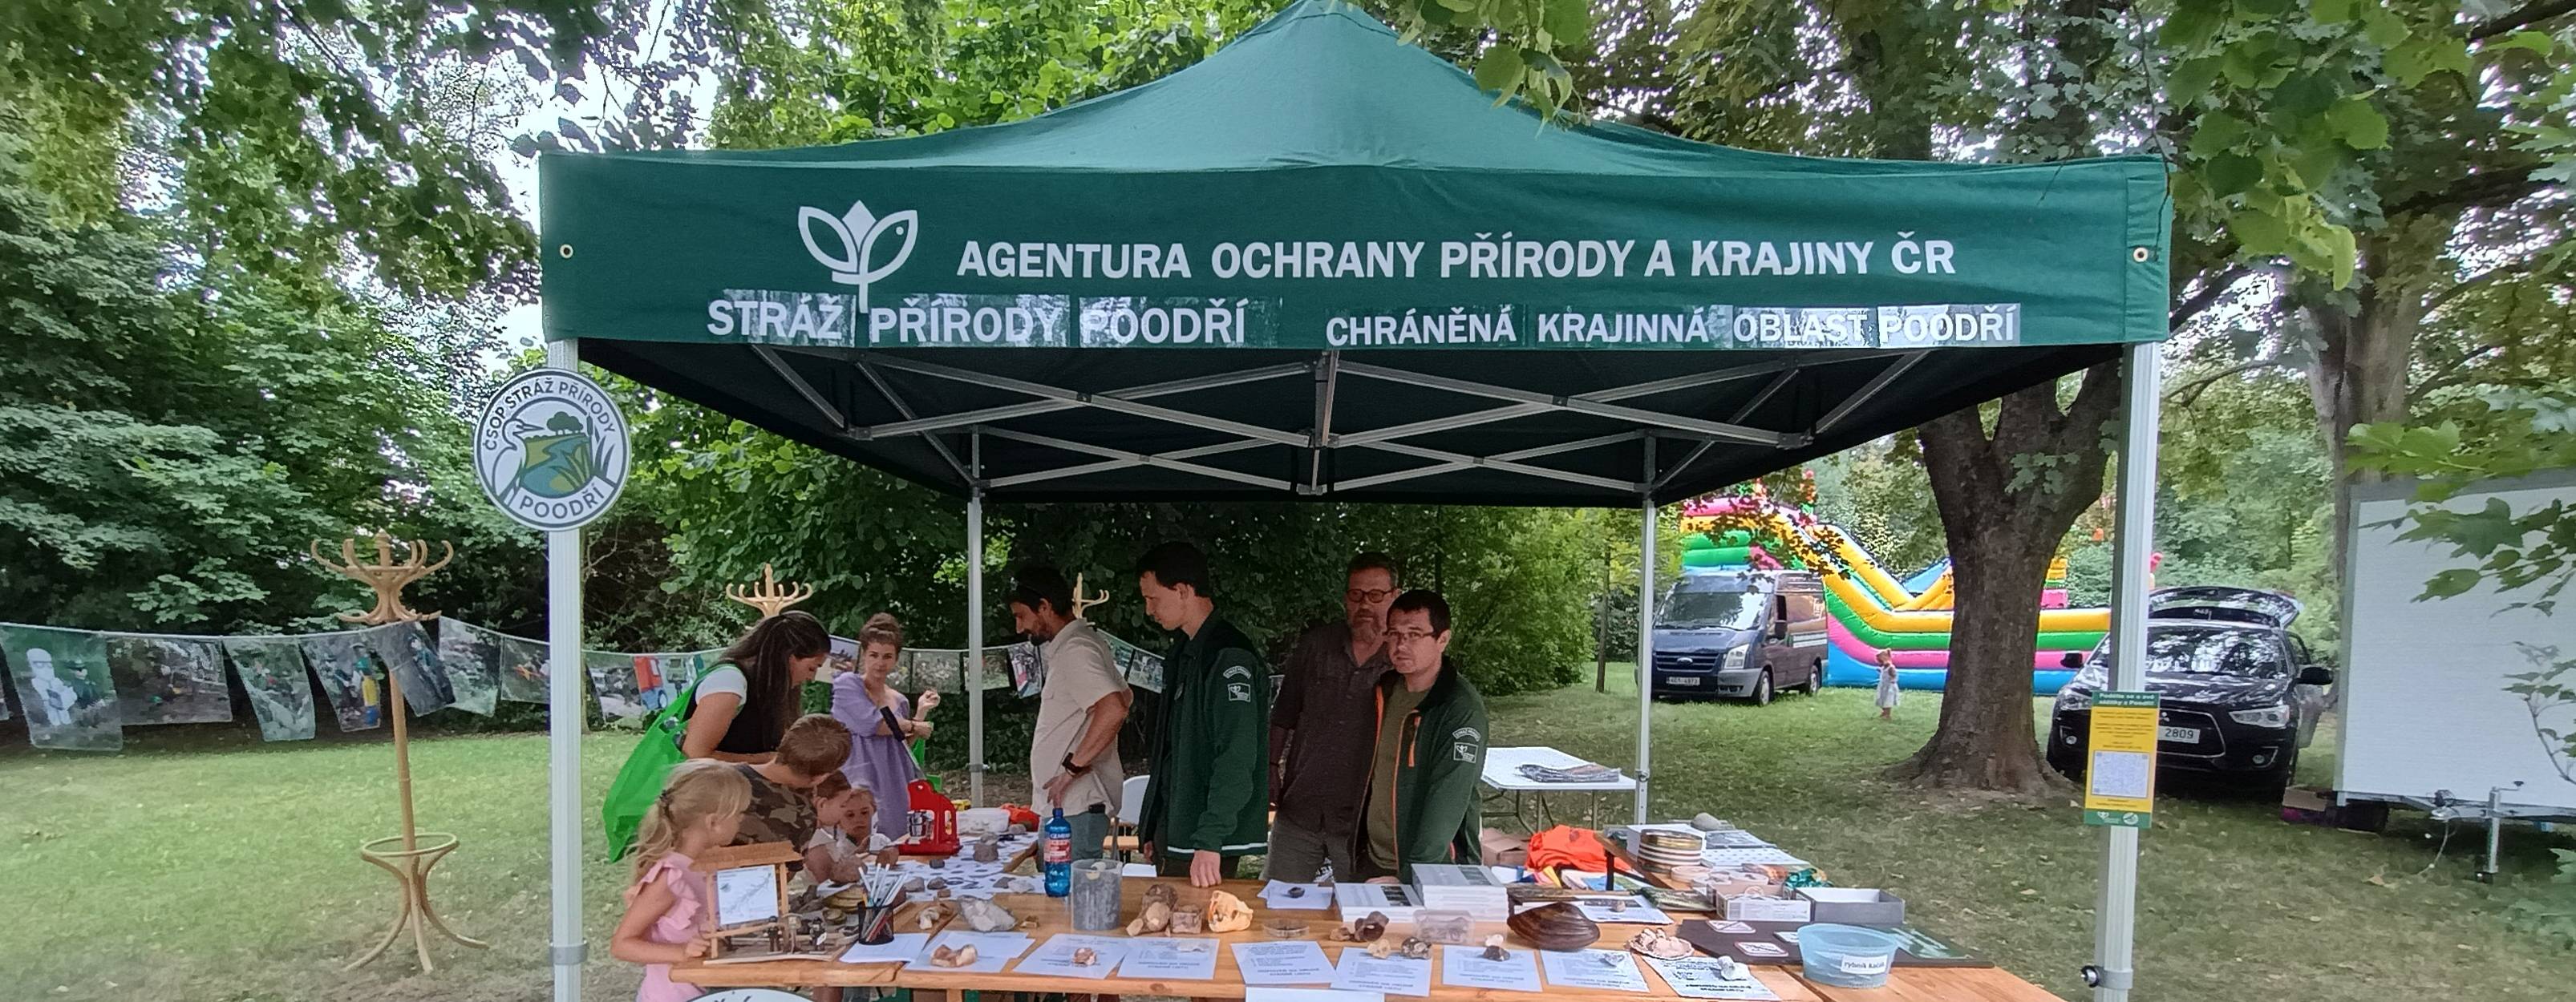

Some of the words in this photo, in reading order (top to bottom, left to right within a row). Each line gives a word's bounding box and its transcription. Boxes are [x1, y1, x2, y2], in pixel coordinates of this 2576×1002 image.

[958, 241, 1192, 279] AGENTURA
[1212, 240, 1425, 278] OCHRANY
[1440, 232, 1635, 278] PŘÍRODY
[1644, 241, 1675, 277] A
[1691, 240, 1874, 277] KRAJINY
[1891, 232, 1956, 275] ČR
[707, 294, 843, 339] STRÁŽ
[871, 297, 1064, 343] PŘÍRODY
[1081, 297, 1250, 344] POODŘÍ
[1326, 307, 1517, 346] CHRÁNĚNÁ
[1538, 308, 1709, 343] KRAJINNÁ
[1733, 313, 1868, 342] OBLAST
[1878, 304, 2018, 343] POODŘÍ
[483, 406, 508, 450] ČSOP
[505, 378, 553, 409] STRÁŽ
[558, 381, 616, 433] PŘÍRODY
[519, 483, 605, 519] POODŘÍ
[2165, 728, 2193, 738] 2809
